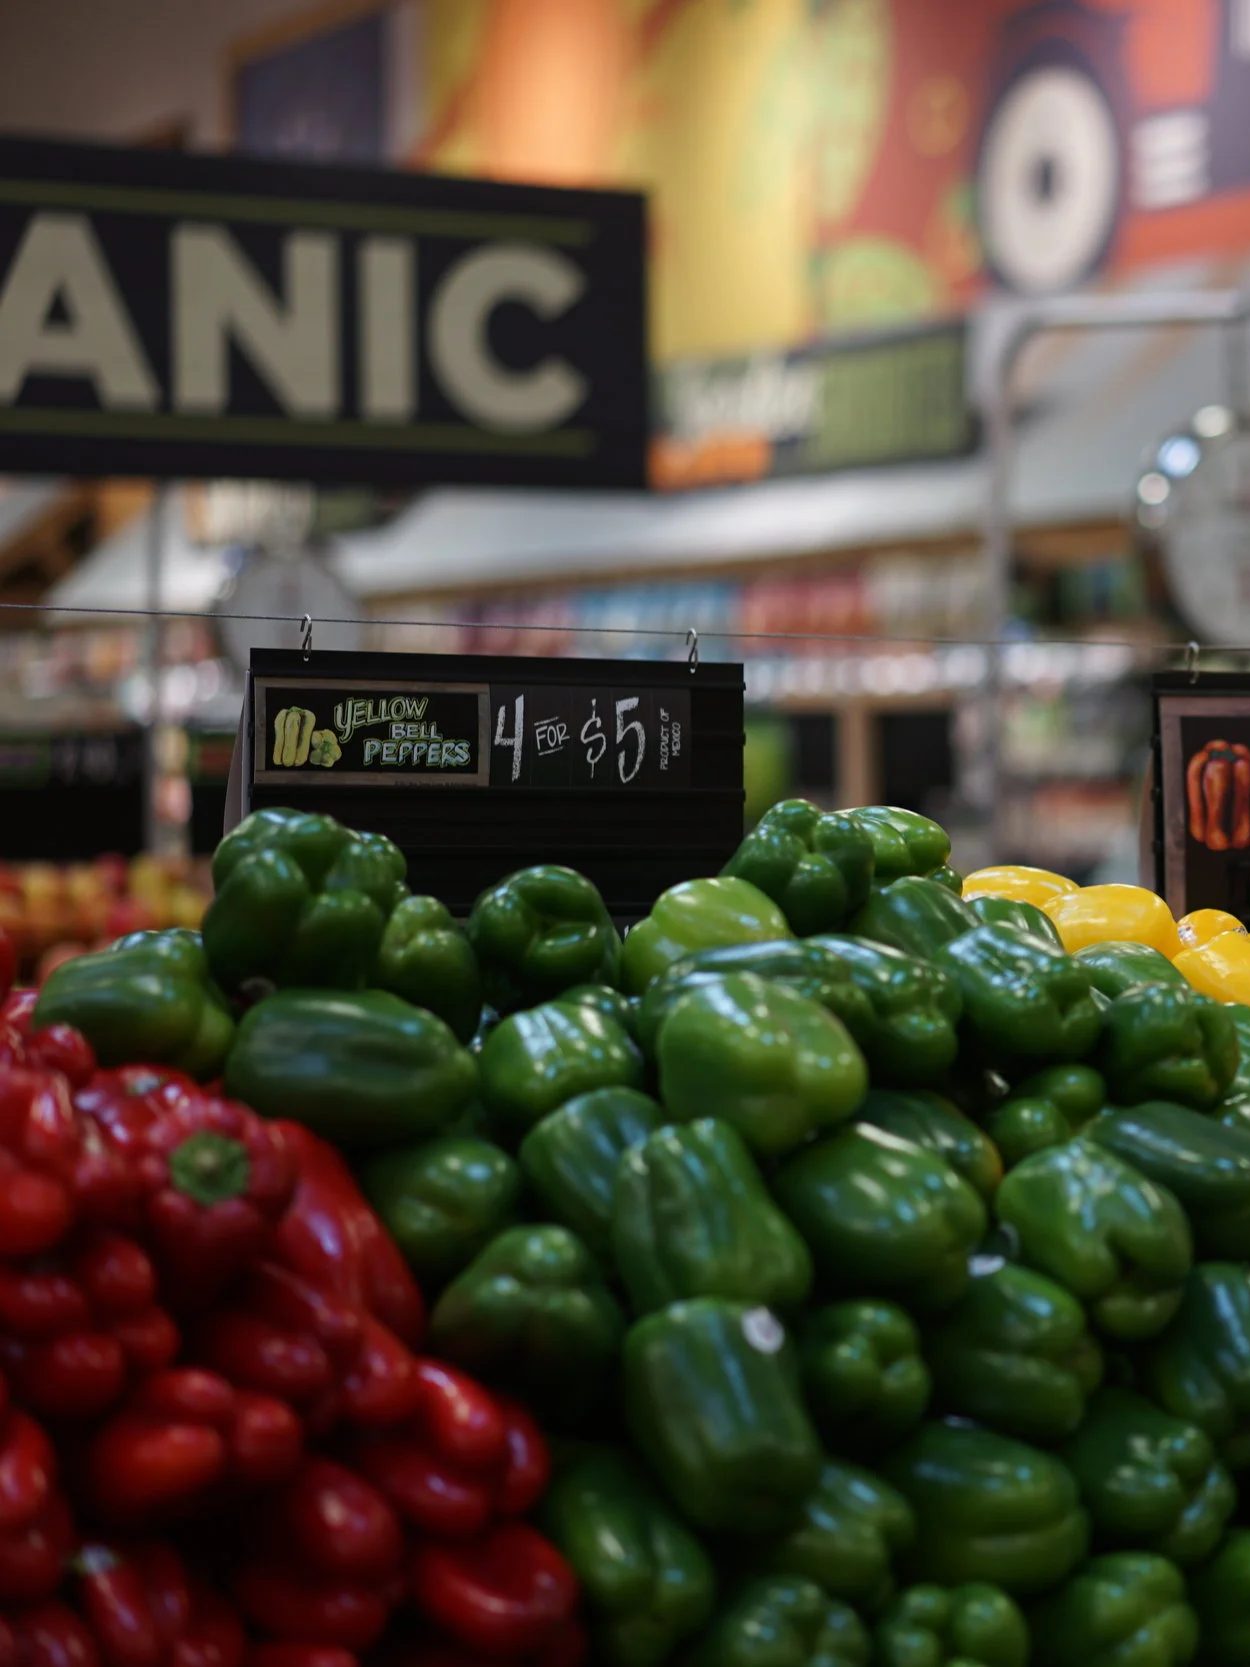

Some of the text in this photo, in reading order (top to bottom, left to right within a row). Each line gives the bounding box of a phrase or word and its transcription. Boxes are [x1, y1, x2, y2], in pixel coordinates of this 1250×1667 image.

[0, 210, 588, 434] ANIC
[334, 696, 429, 743] YELLOW
[389, 721, 443, 740] BELL
[494, 694, 646, 784] 4 FOR $5
[659, 708, 670, 770] PRODUCT OF
[363, 738, 471, 767] PEPPERS
